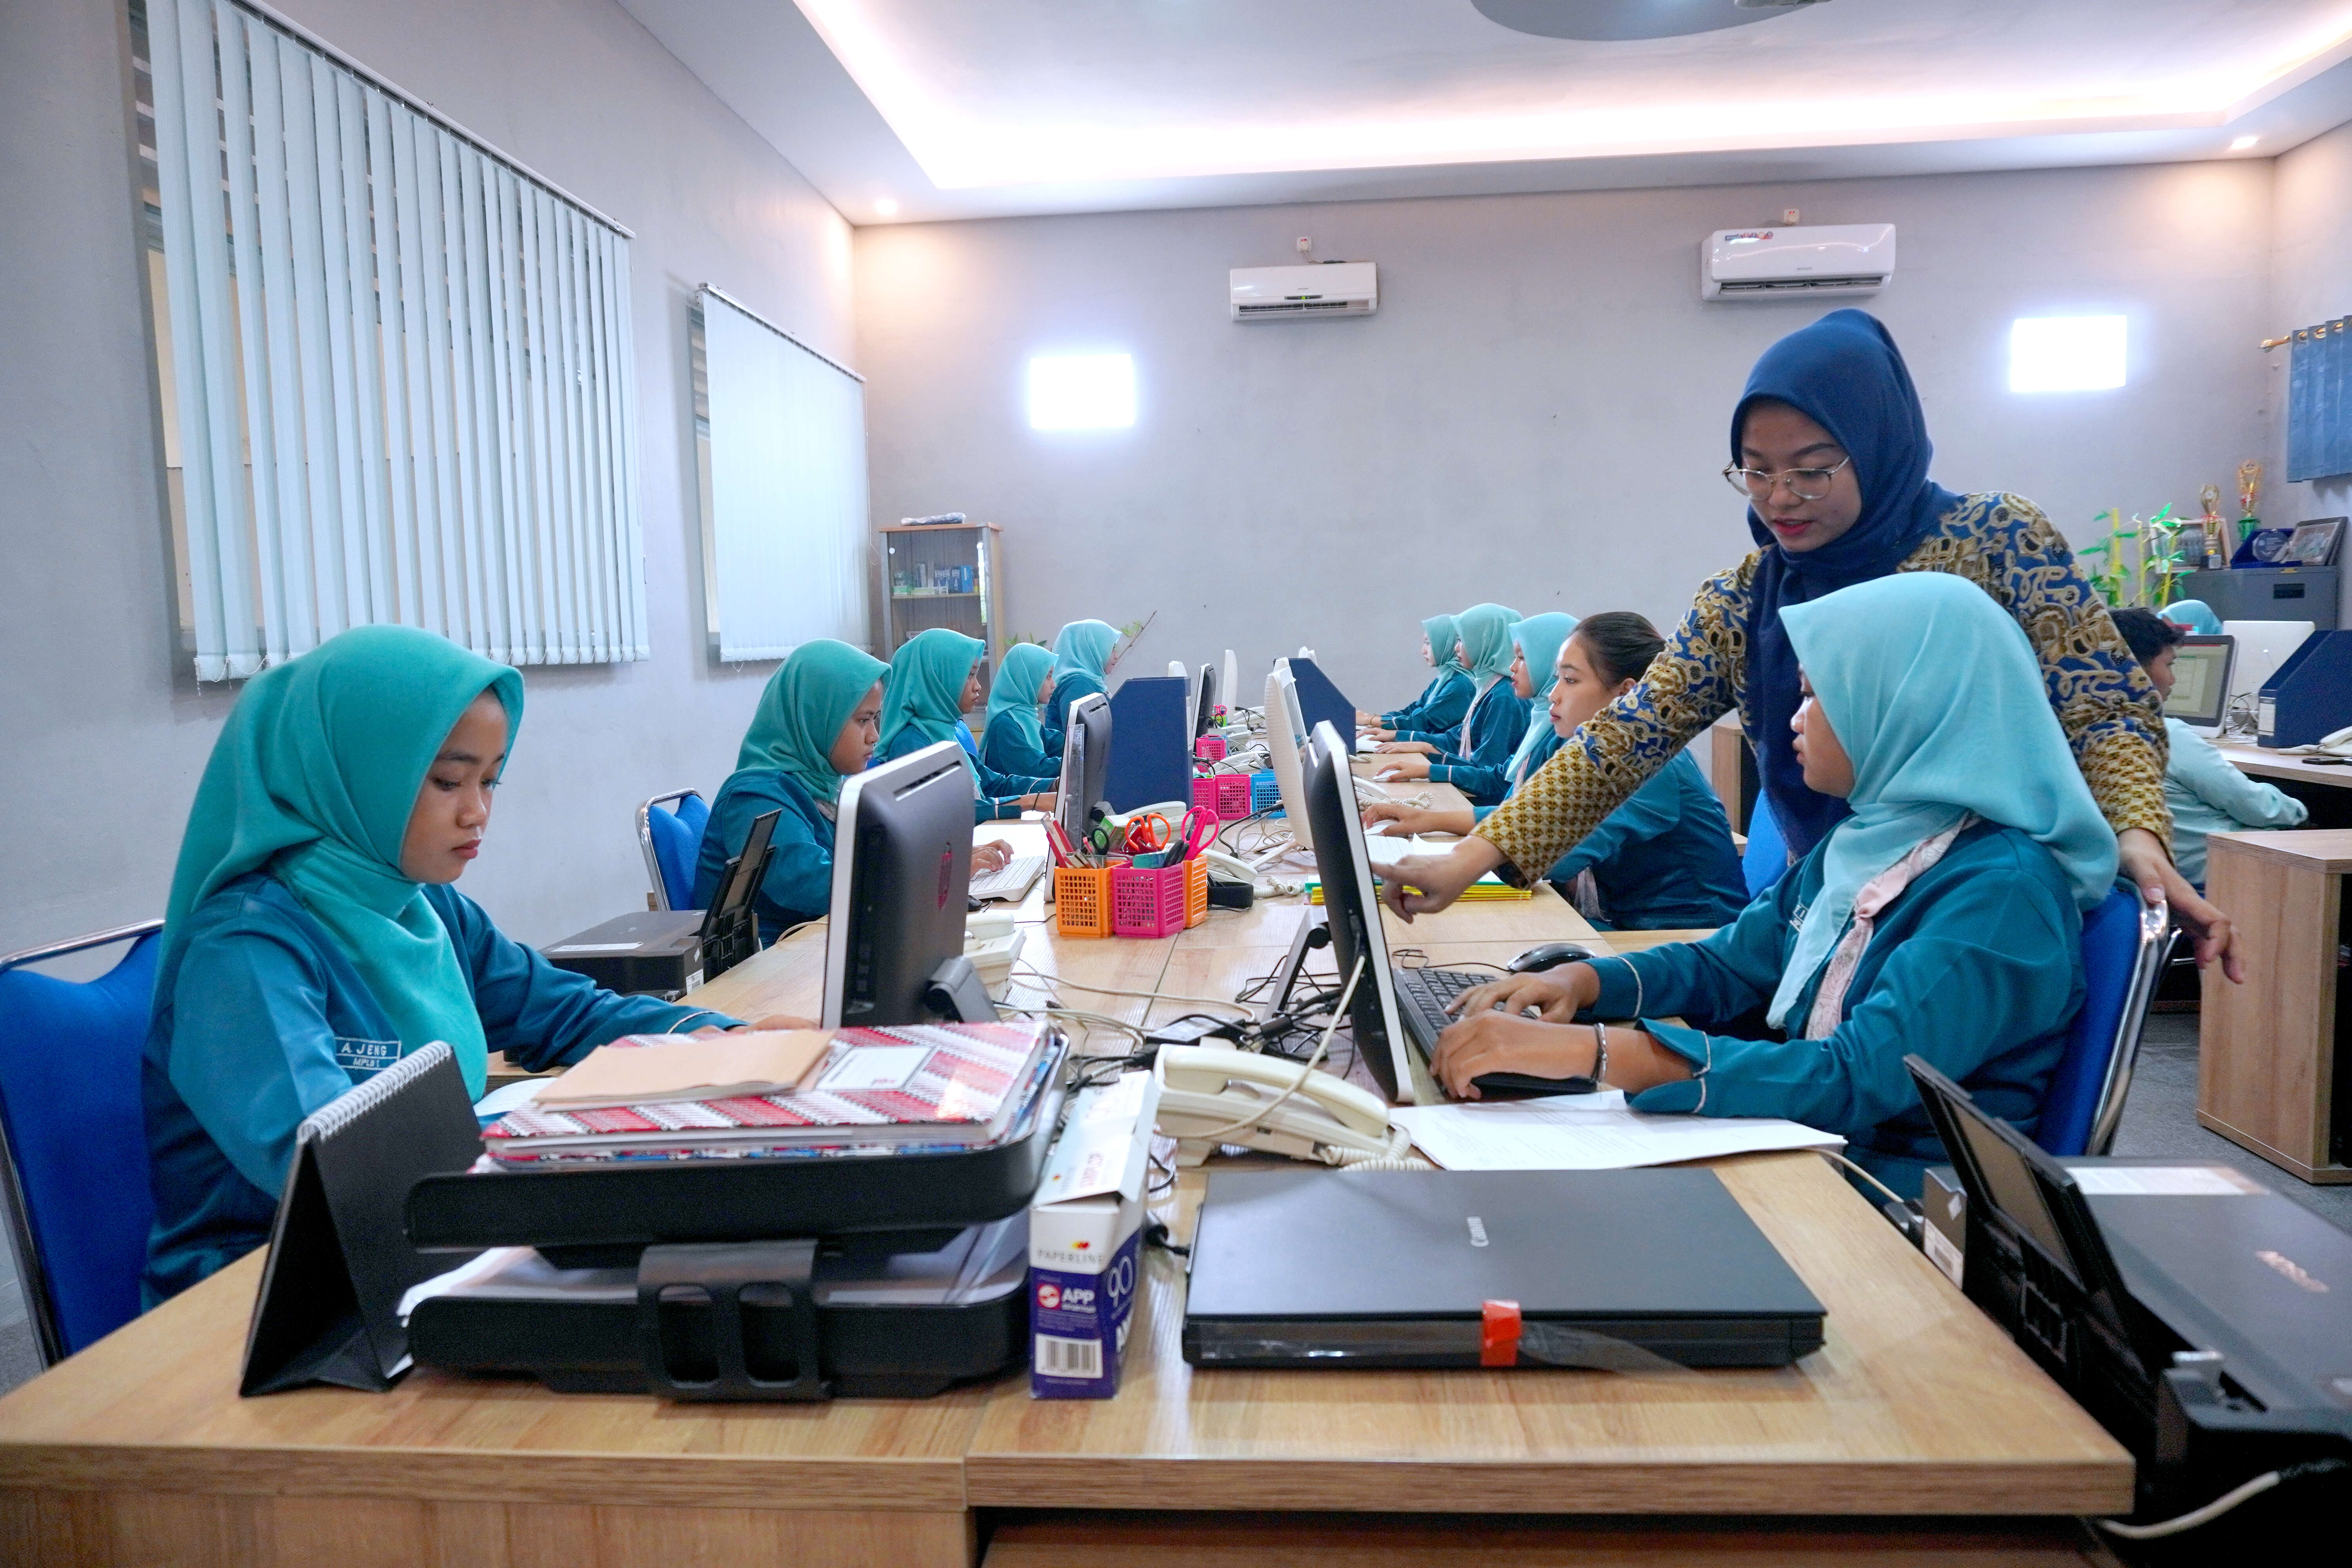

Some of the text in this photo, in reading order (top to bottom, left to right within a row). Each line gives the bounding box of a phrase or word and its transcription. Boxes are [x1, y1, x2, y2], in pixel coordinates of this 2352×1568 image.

[1037, 1249, 1103, 1264] PAPERLINE
[1108, 1256, 1133, 1308] 90
[1062, 1287, 1095, 1305] APP
